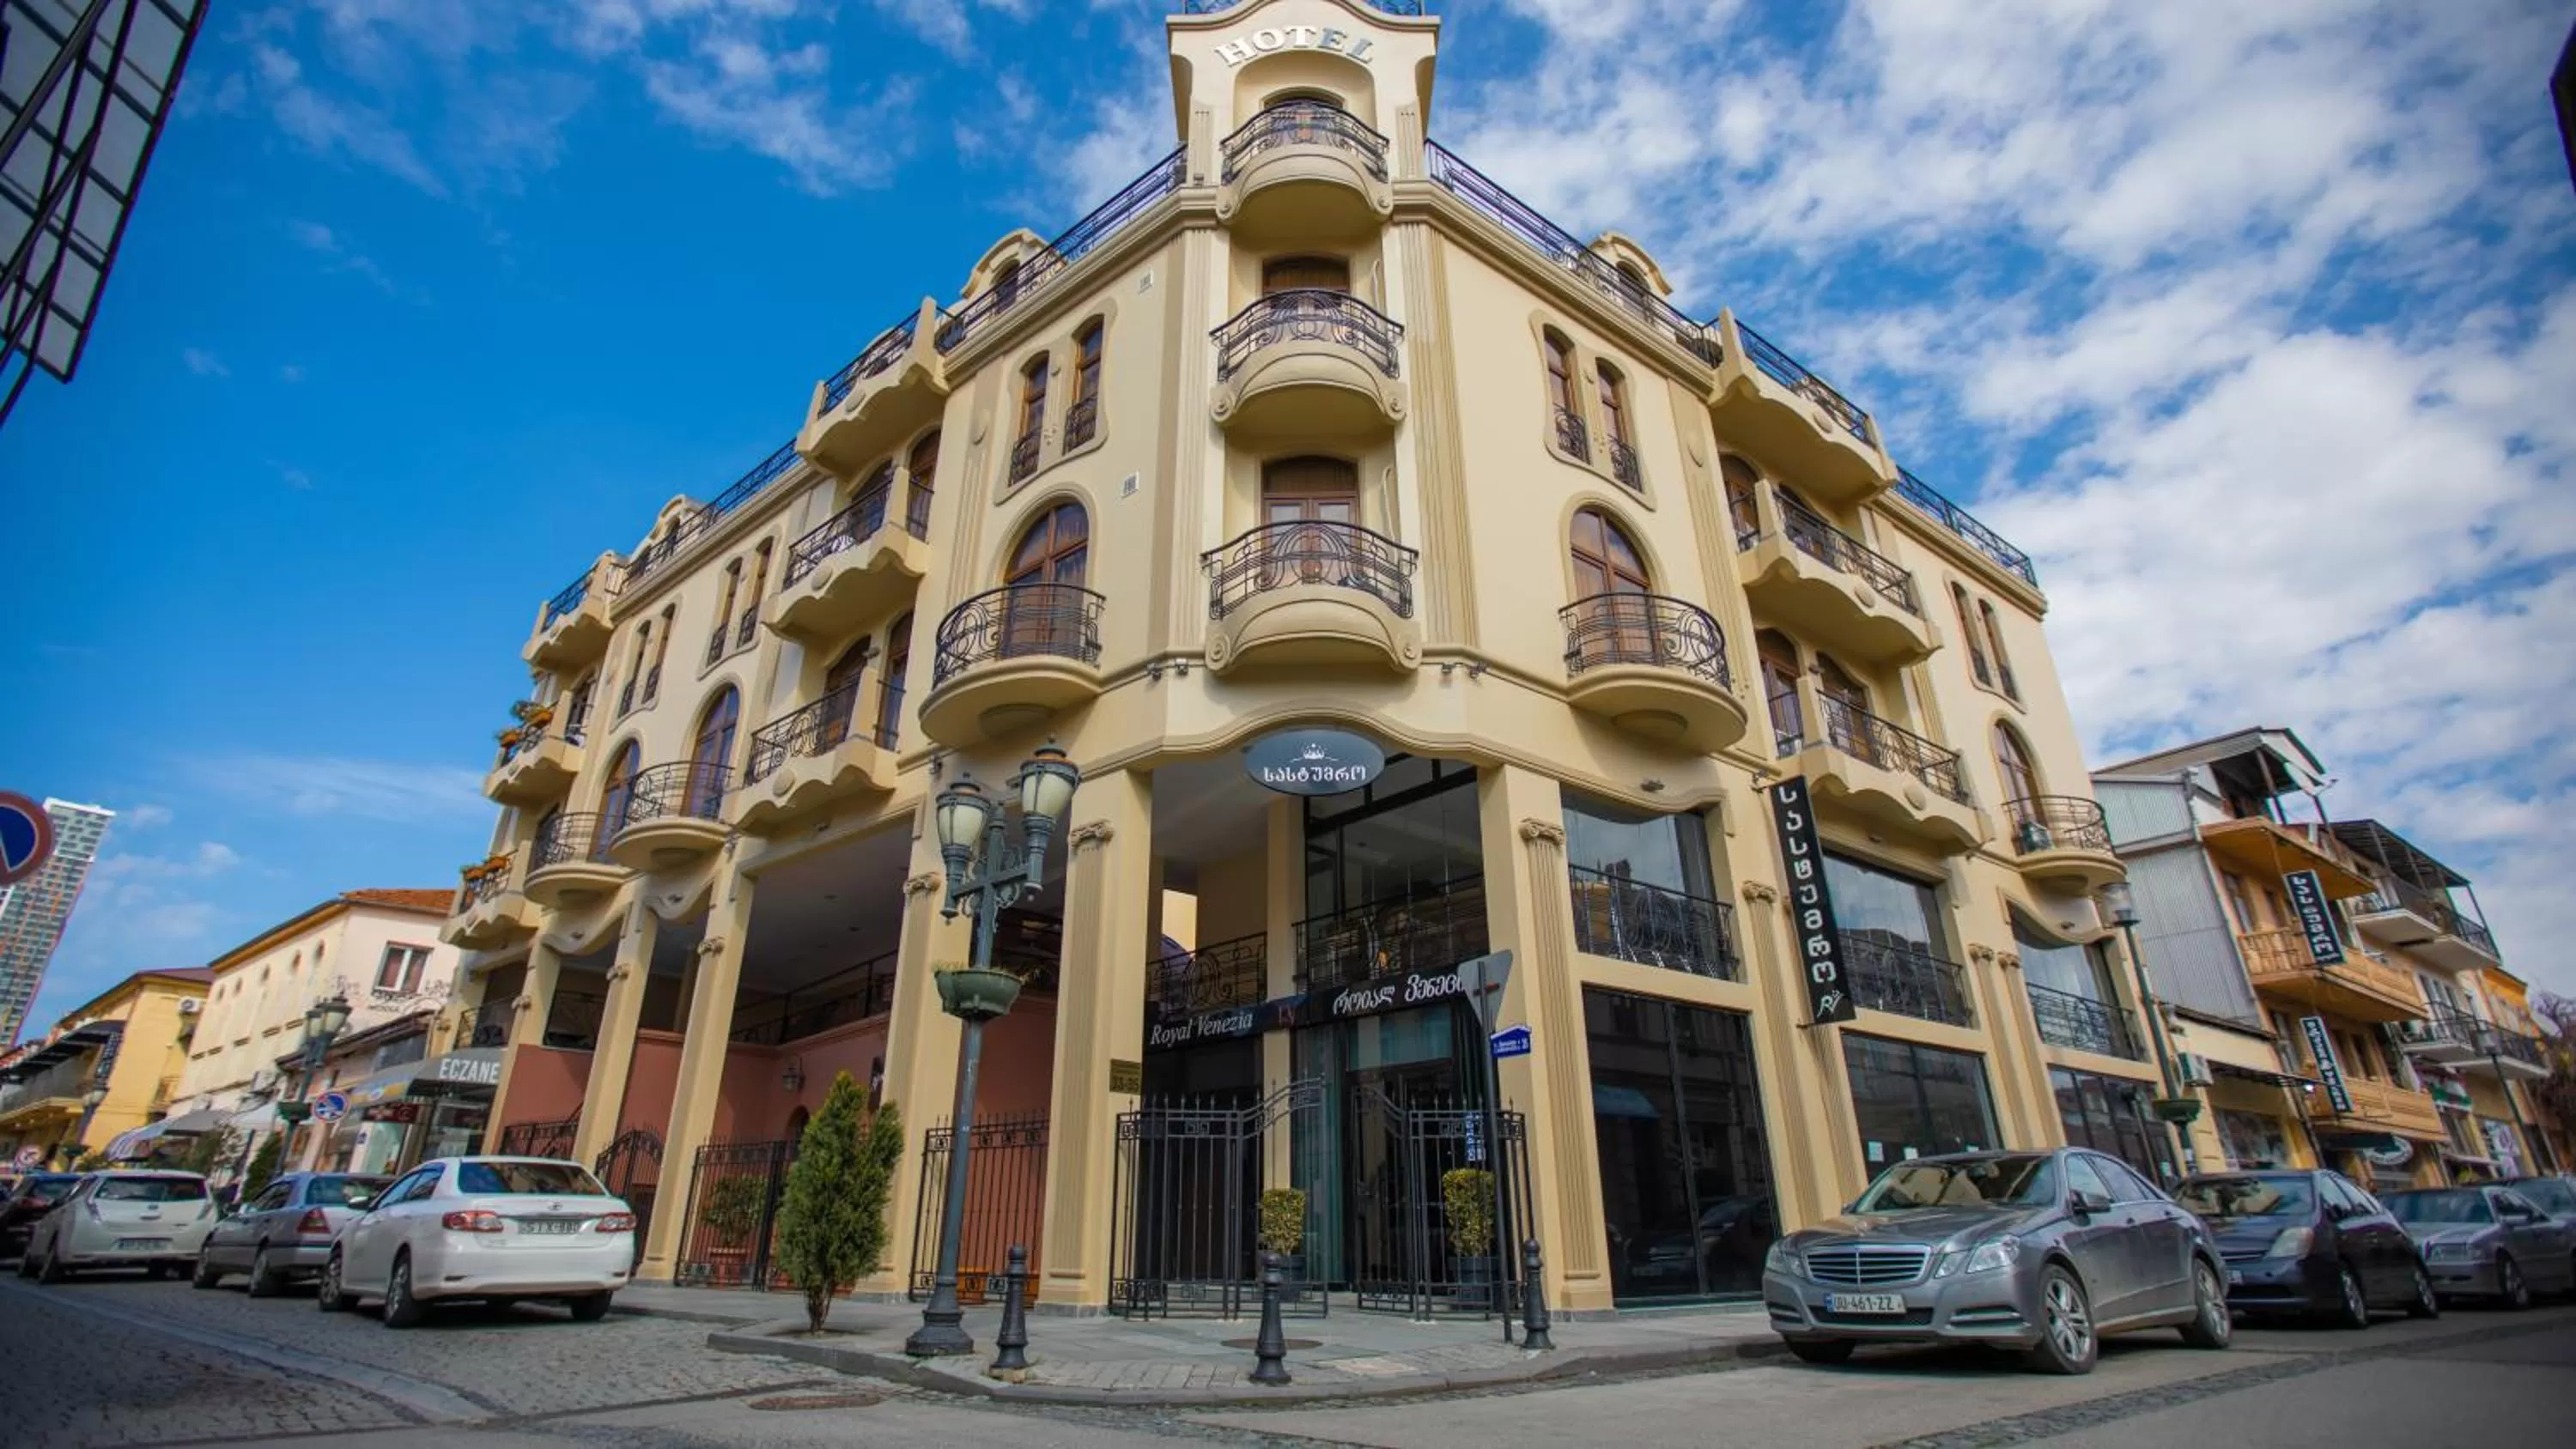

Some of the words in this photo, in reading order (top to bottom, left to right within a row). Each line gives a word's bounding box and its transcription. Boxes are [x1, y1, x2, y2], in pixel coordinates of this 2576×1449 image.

[1214, 26, 1374, 67] HOTEL
[1263, 764, 1367, 782] სასტუმრო
[1778, 785, 1836, 984] სასტუმრო
[1151, 1017, 1193, 1047] Royal
[1197, 1011, 1253, 1037] Venezia
[439, 1058, 501, 1083] ECZANE
